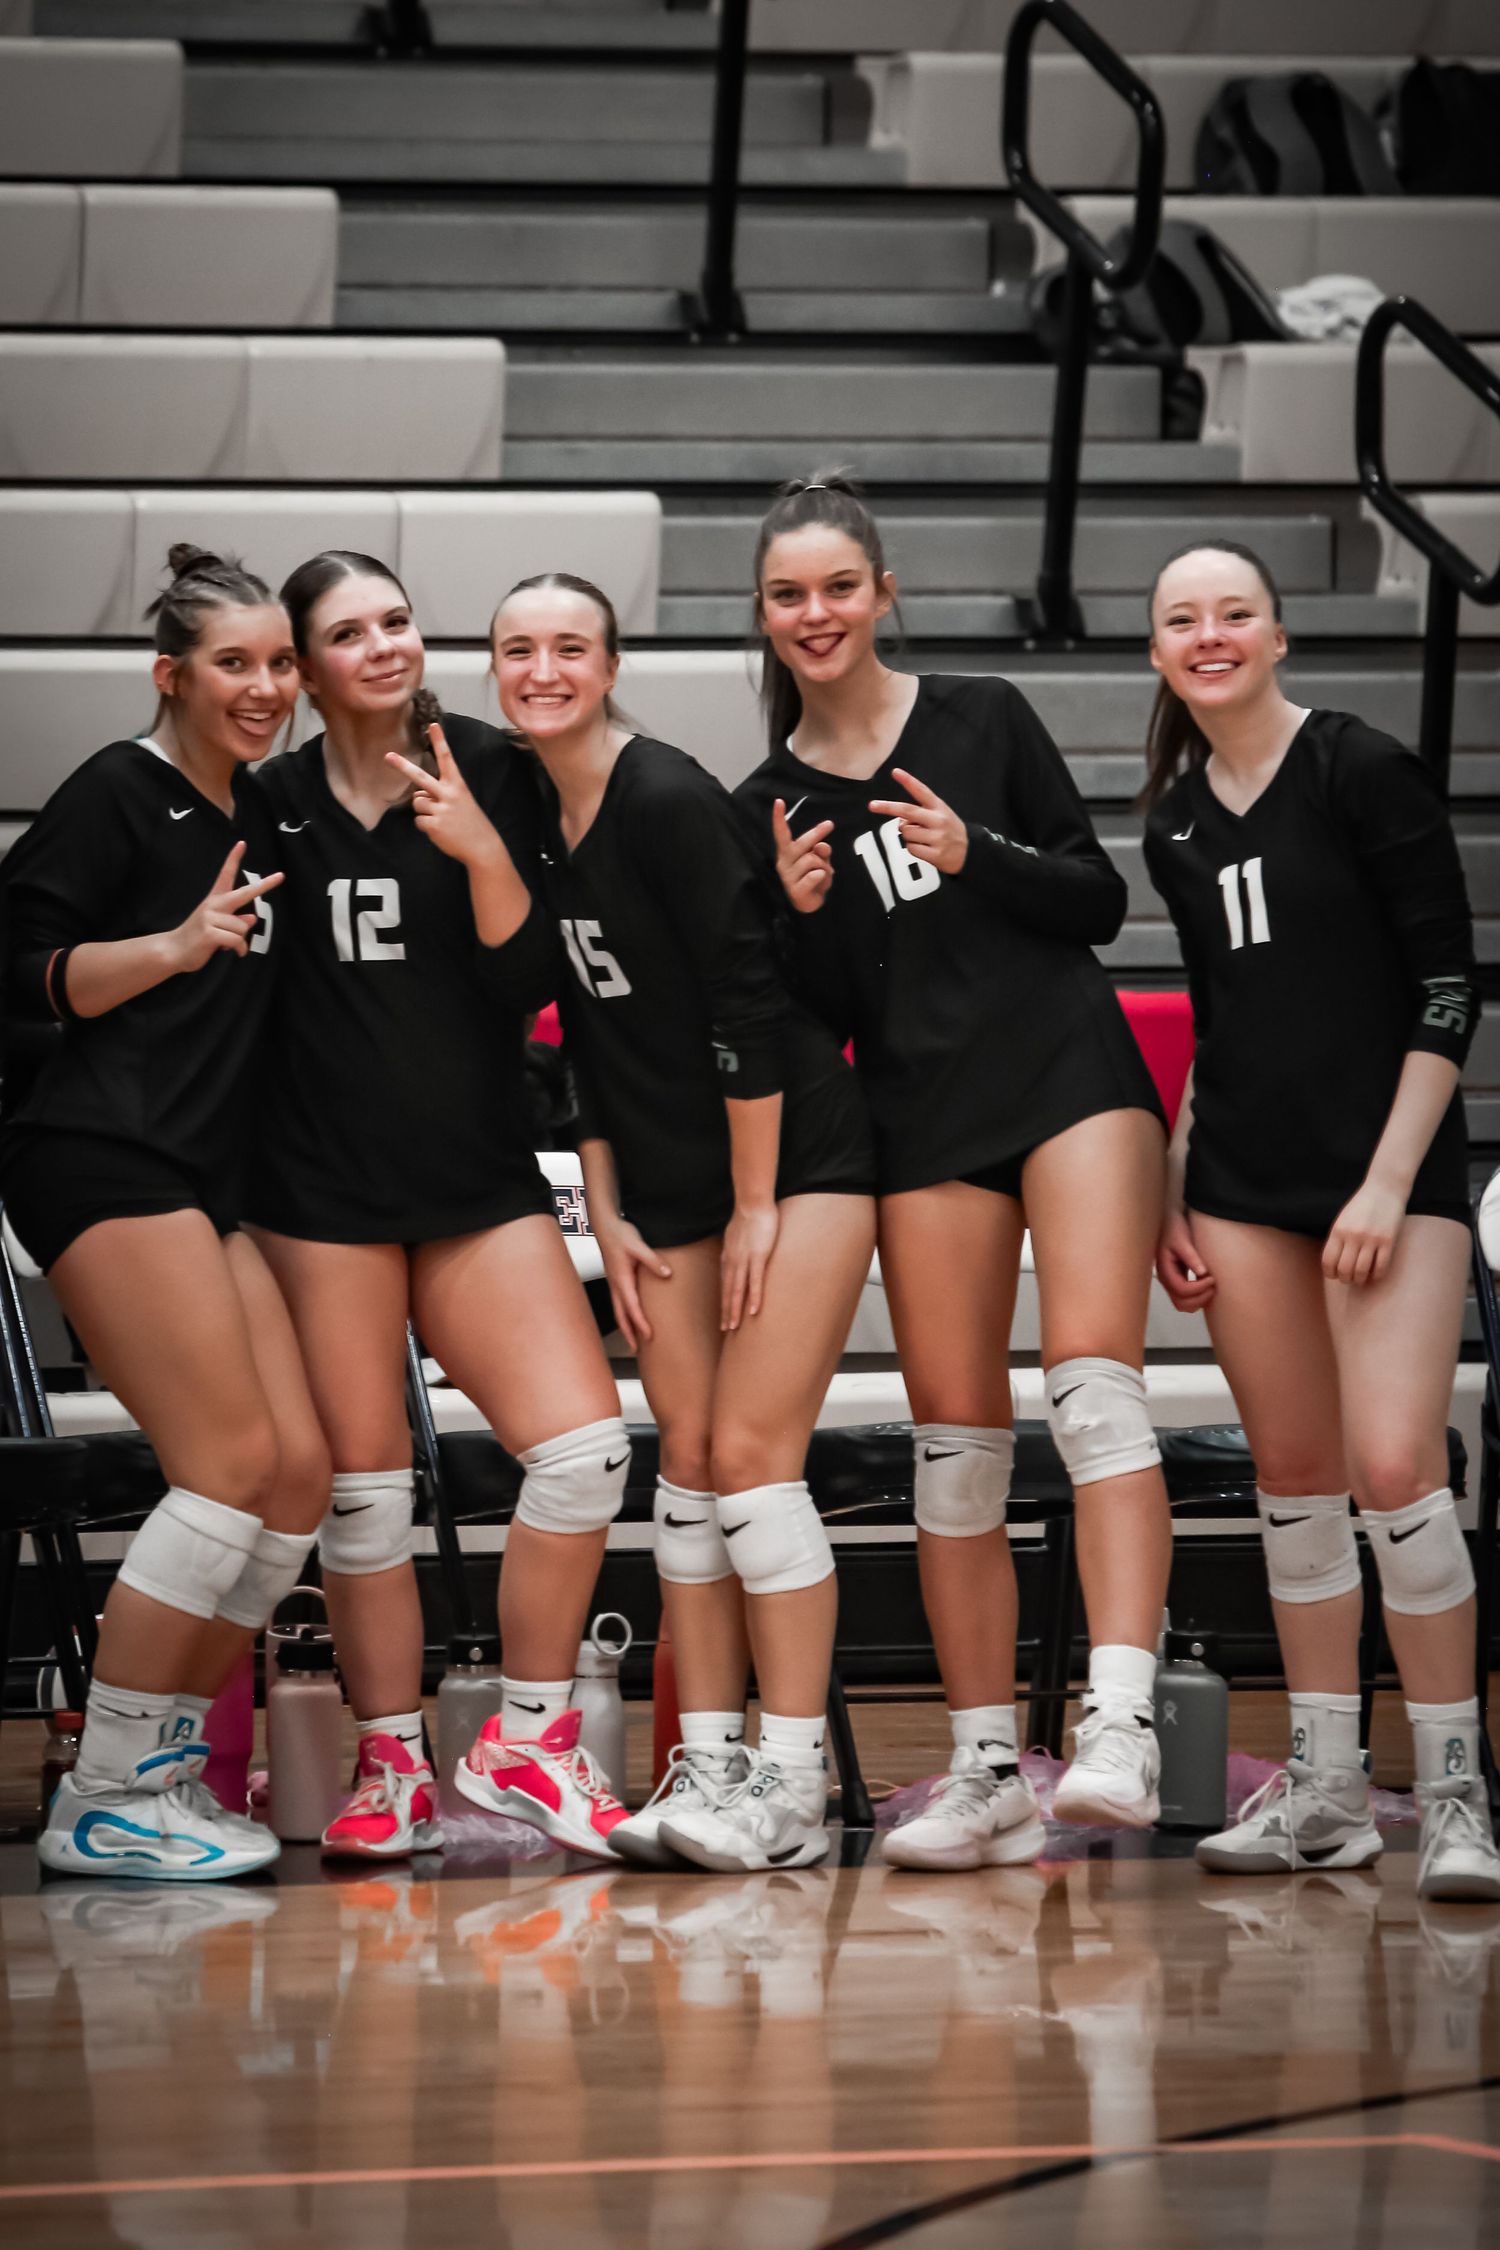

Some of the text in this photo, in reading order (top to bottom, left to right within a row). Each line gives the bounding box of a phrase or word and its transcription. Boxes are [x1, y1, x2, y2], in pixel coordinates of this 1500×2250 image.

[326, 877, 406, 962] 12
[1217, 856, 1272, 951] 11
[559, 918, 633, 999] 15
